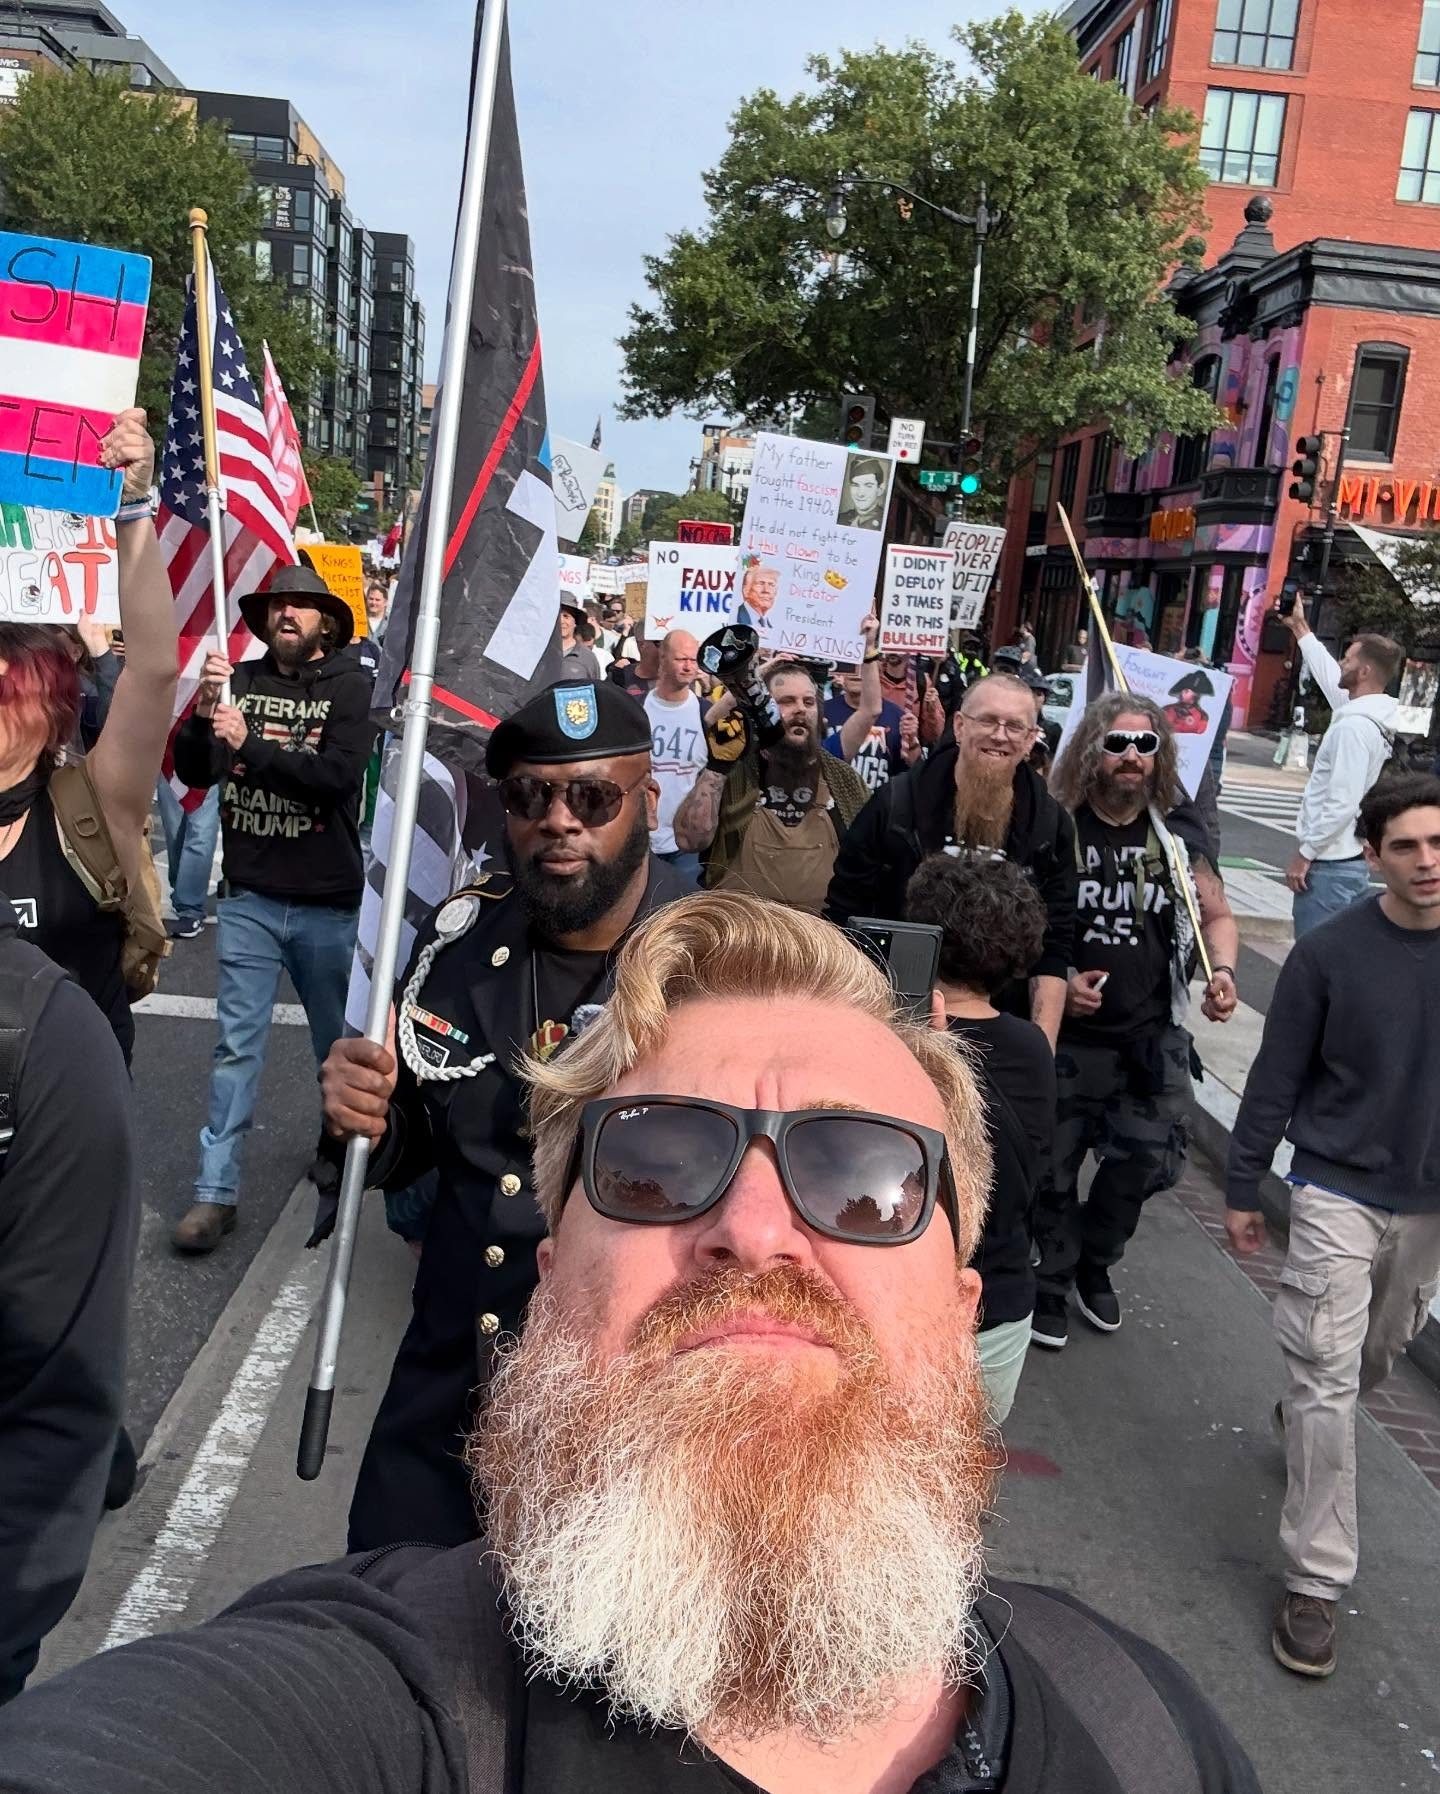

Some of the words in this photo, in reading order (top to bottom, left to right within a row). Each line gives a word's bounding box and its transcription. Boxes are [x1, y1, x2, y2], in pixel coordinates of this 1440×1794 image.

[901, 423, 914, 431] NO
[760, 442, 783, 469] My
[789, 447, 832, 470] father
[755, 466, 794, 492] fought
[796, 474, 838, 497] fascism
[760, 495, 769, 504] in
[774, 493, 793, 508] the
[799, 496, 834, 517] 1940s
[750, 516, 765, 533] He
[769, 519, 785, 535] did
[789, 529, 808, 538] not
[812, 528, 840, 546] fight
[842, 533, 857, 545] for
[945, 531, 1003, 553] PEOPLE
[657, 549, 680, 564] NO
[758, 540, 779, 552] this
[785, 542, 820, 558] Clown
[828, 550, 840, 563] to
[845, 552, 857, 566] be
[893, 556, 897, 568] I
[681, 568, 737, 592] FAUX
[792, 563, 819, 588] King
[895, 575, 945, 590] DEPLOY
[953, 571, 993, 593] OFIT
[789, 584, 839, 603] Dictator
[891, 594, 900, 606] 3
[906, 595, 944, 610] TIMES
[786, 607, 835, 628] President
[886, 613, 911, 628] FOR
[916, 615, 943, 629] THIS
[813, 636, 864, 660] KINGS
[882, 631, 945, 647] BULLSHIT
[1123, 652, 1167, 681] FOUGHT
[231, 694, 332, 721] VETERANS
[652, 725, 698, 762] 647
[223, 781, 321, 815] AGAINS
[231, 806, 312, 838] TRUMP
